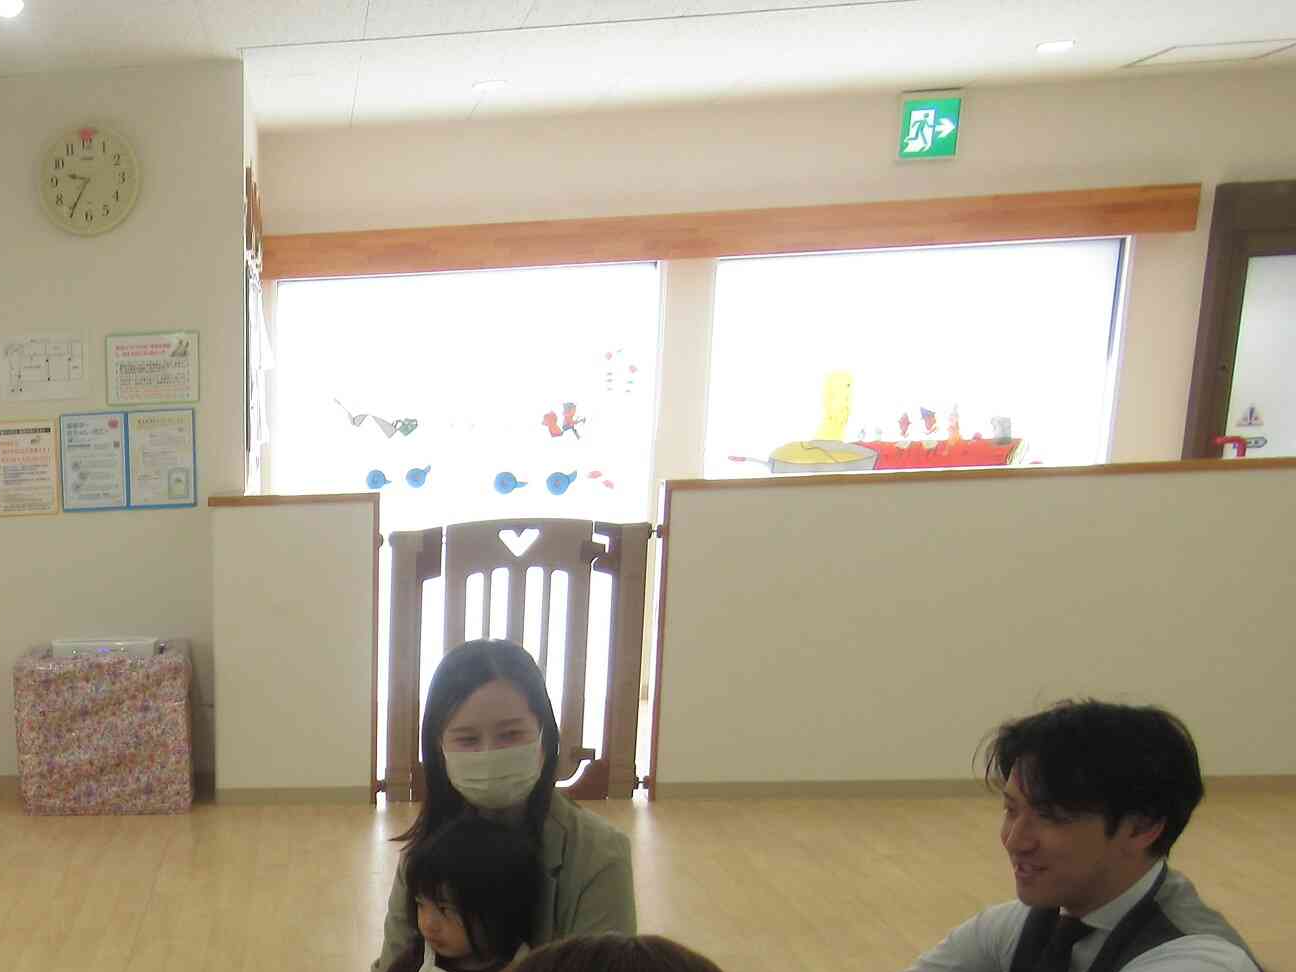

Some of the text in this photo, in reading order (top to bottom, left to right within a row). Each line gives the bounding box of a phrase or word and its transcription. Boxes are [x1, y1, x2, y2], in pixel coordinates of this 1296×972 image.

[112, 152, 121, 166] 2
[50, 176, 58, 188] 9
[55, 193, 64, 206] 8
